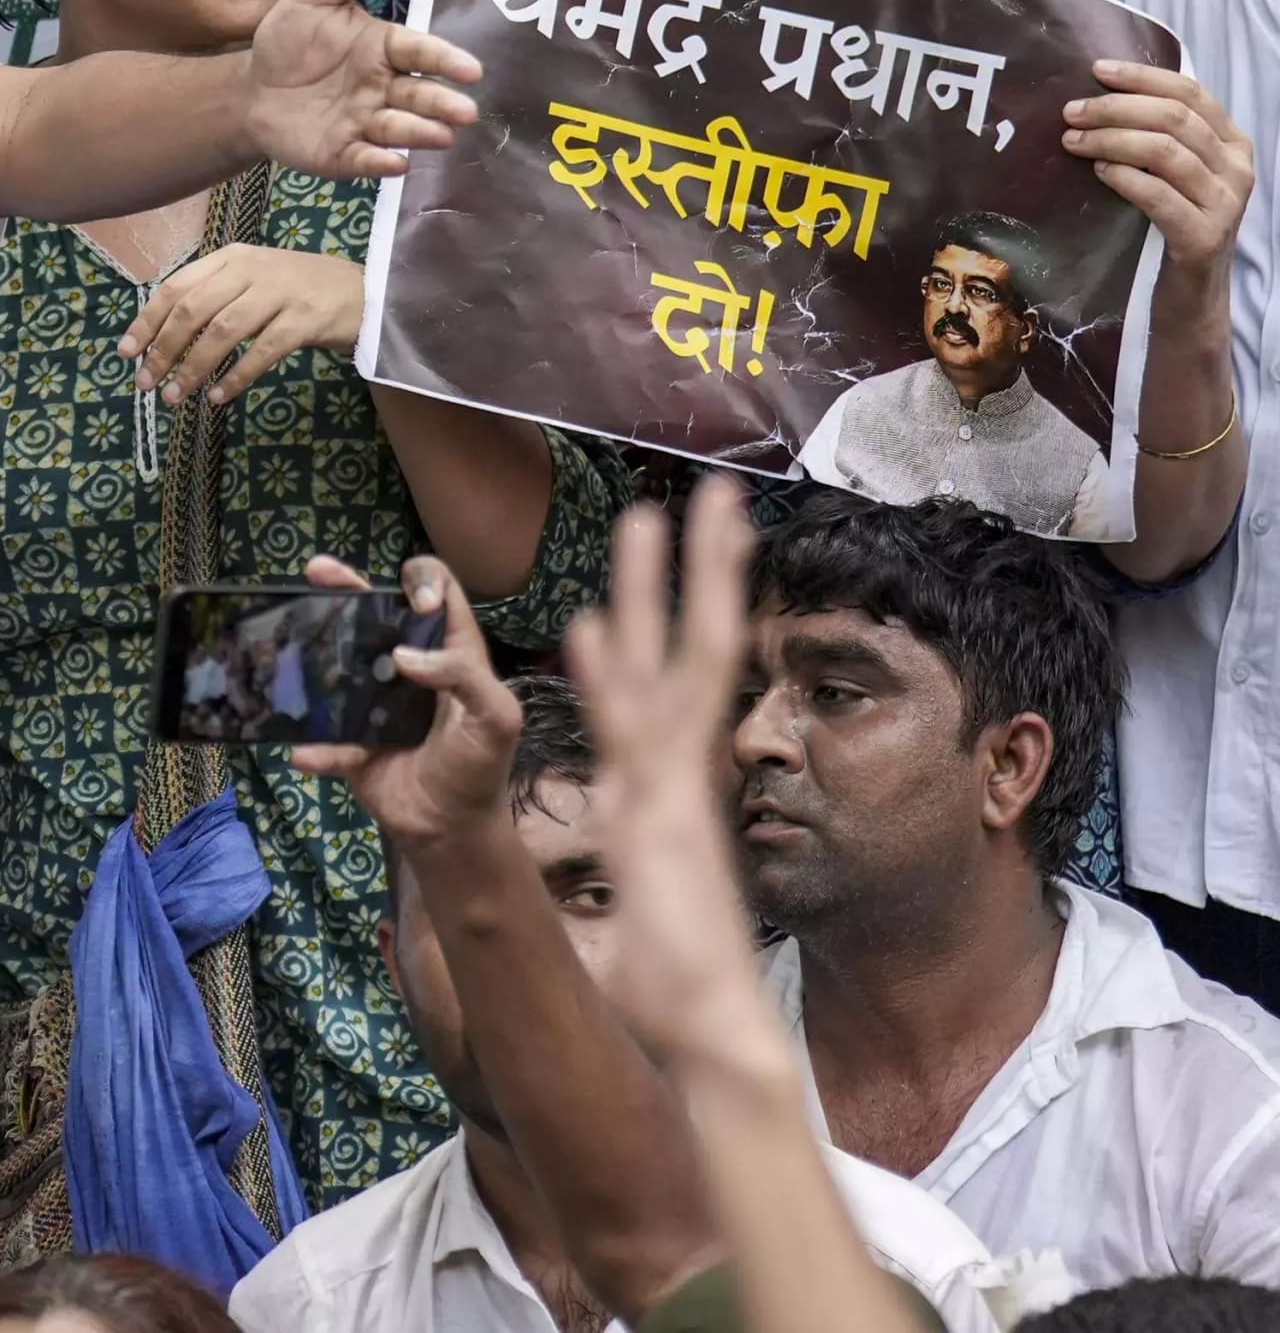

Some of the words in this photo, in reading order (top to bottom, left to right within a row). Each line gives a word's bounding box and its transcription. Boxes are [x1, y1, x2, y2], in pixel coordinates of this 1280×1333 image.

[758, 5, 1017, 152] प्रधान,
[547, 102, 889, 260] इस्तीफ़ा
[650, 262, 774, 376] दो!
